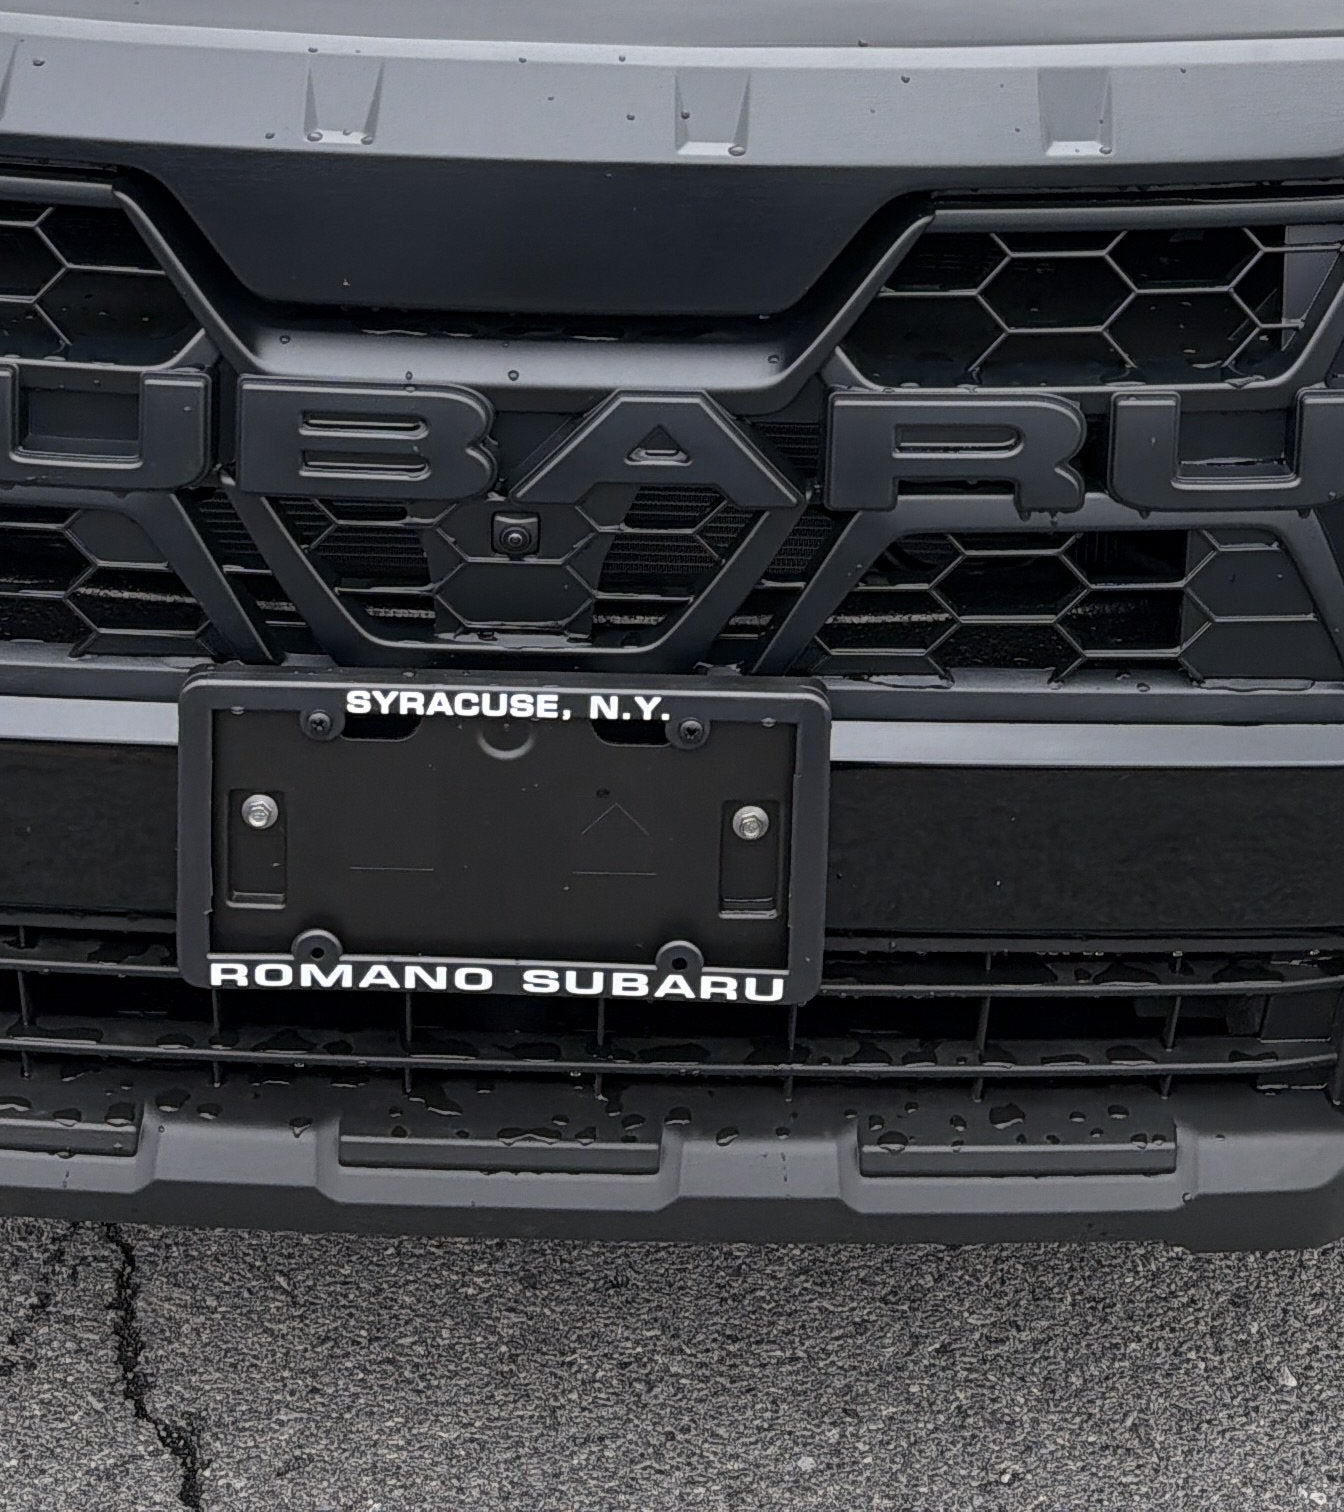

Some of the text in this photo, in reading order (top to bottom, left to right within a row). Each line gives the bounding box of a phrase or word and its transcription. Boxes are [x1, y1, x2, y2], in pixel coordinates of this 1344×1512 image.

[346, 690, 671, 721] SYRACUSE, N.Y.
[209, 963, 785, 1002] ROMANO SUBARU
